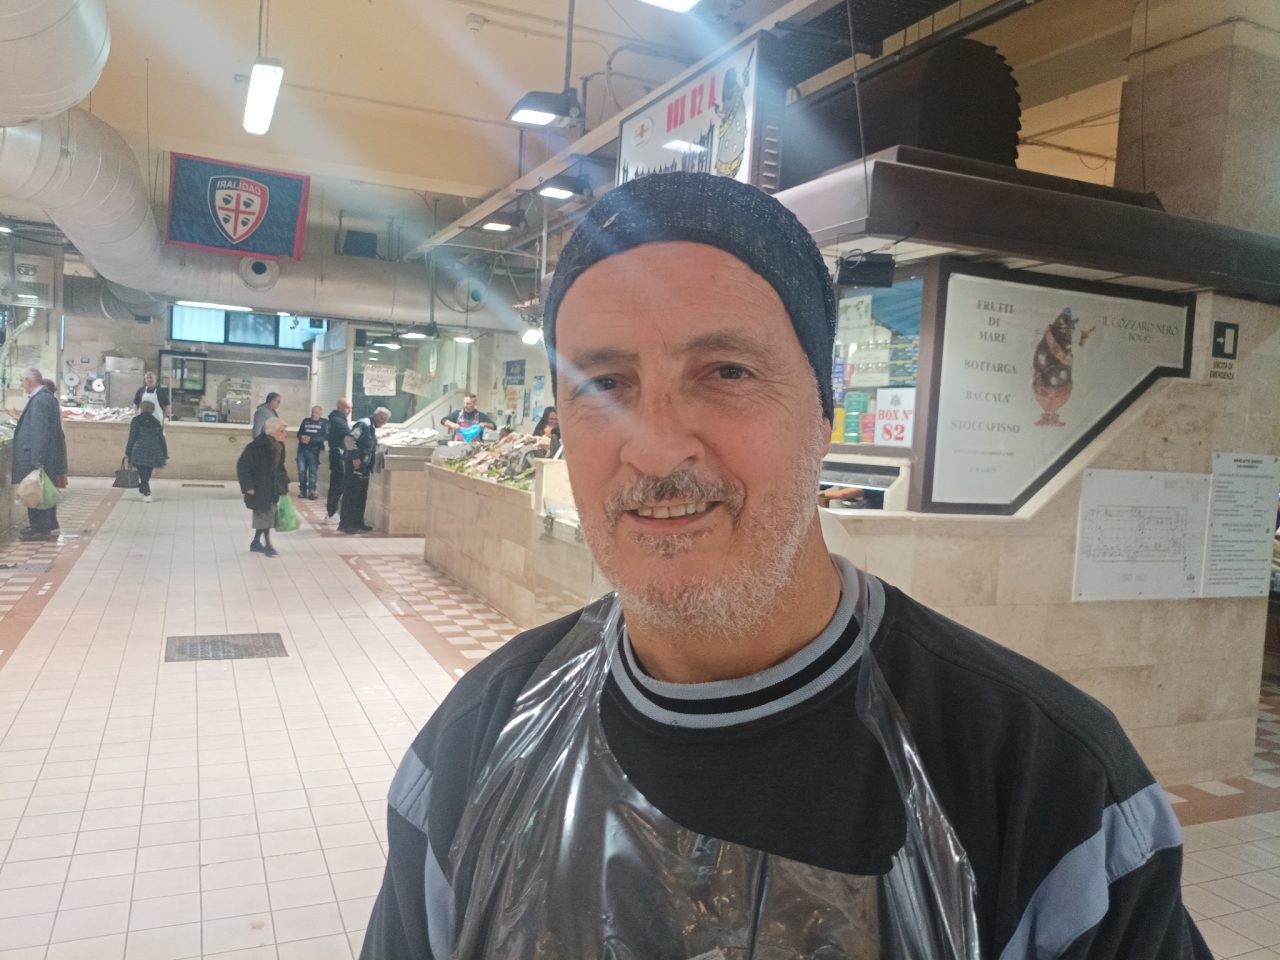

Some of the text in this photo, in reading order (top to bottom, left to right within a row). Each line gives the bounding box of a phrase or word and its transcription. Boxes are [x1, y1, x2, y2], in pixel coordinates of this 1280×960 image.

[977, 299, 1014, 313] FRUTTI
[988, 316, 1000, 327] DI
[979, 331, 1008, 344] MARE
[964, 359, 1017, 374] BOTTARGA
[878, 409, 899, 421] BOX
[882, 423, 905, 441] 82
[950, 420, 1021, 434] STOCCAFISSO
